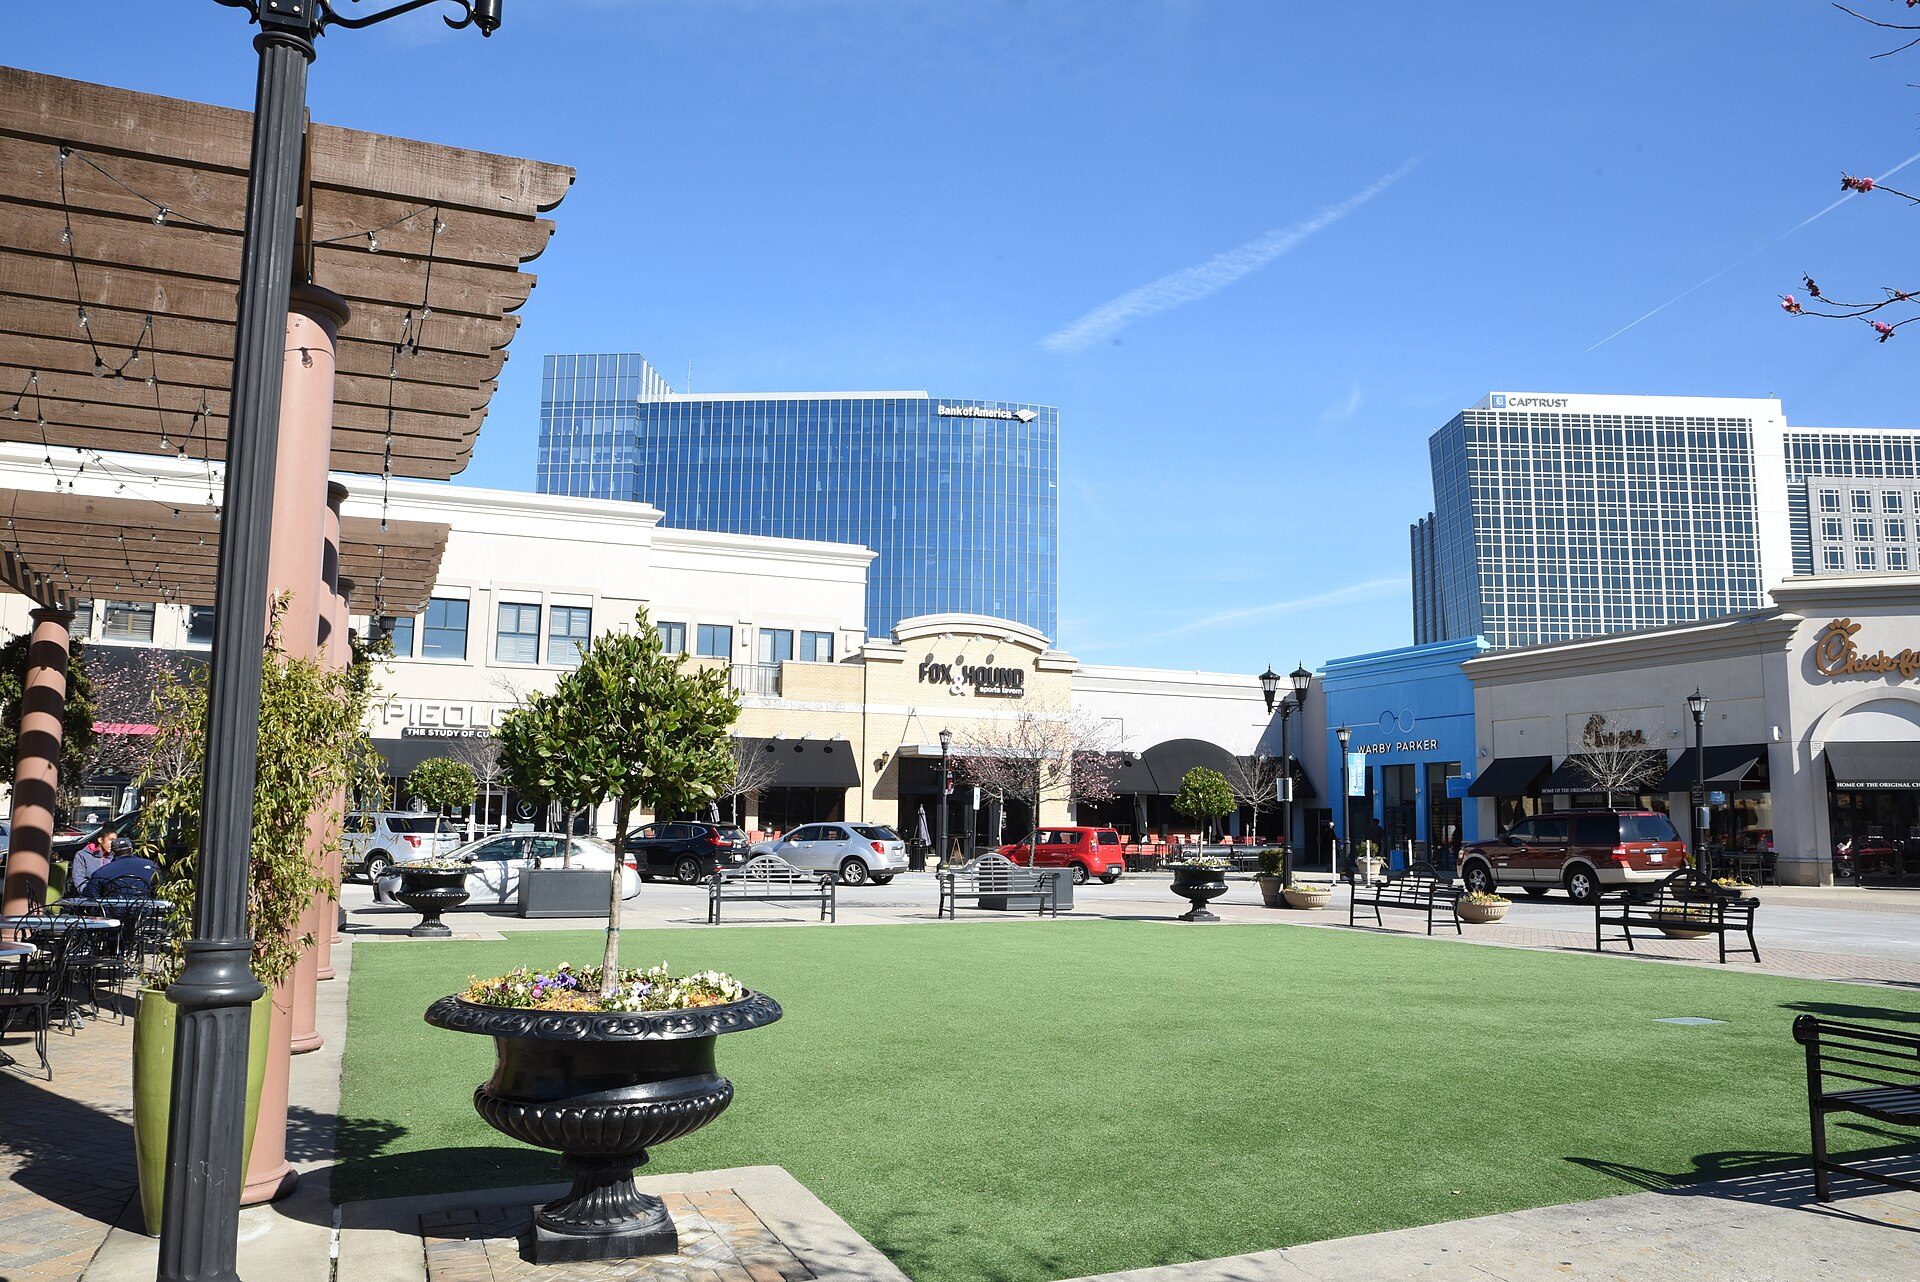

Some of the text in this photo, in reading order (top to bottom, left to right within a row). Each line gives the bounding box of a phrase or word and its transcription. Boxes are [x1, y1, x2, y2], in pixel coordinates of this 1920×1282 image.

[1509, 397, 1568, 408] CAPTRUST
[938, 405, 1011, 419] Bank of America
[1816, 618, 1920, 678] Chick-fi
[918, 662, 1024, 696] FOX & HOUND
[980, 686, 1001, 695] sports
[406, 728, 426, 736] THE
[428, 728, 459, 737] STUDY
[461, 730, 474, 738] OF
[1357, 739, 1438, 754] WARBY PARKER
